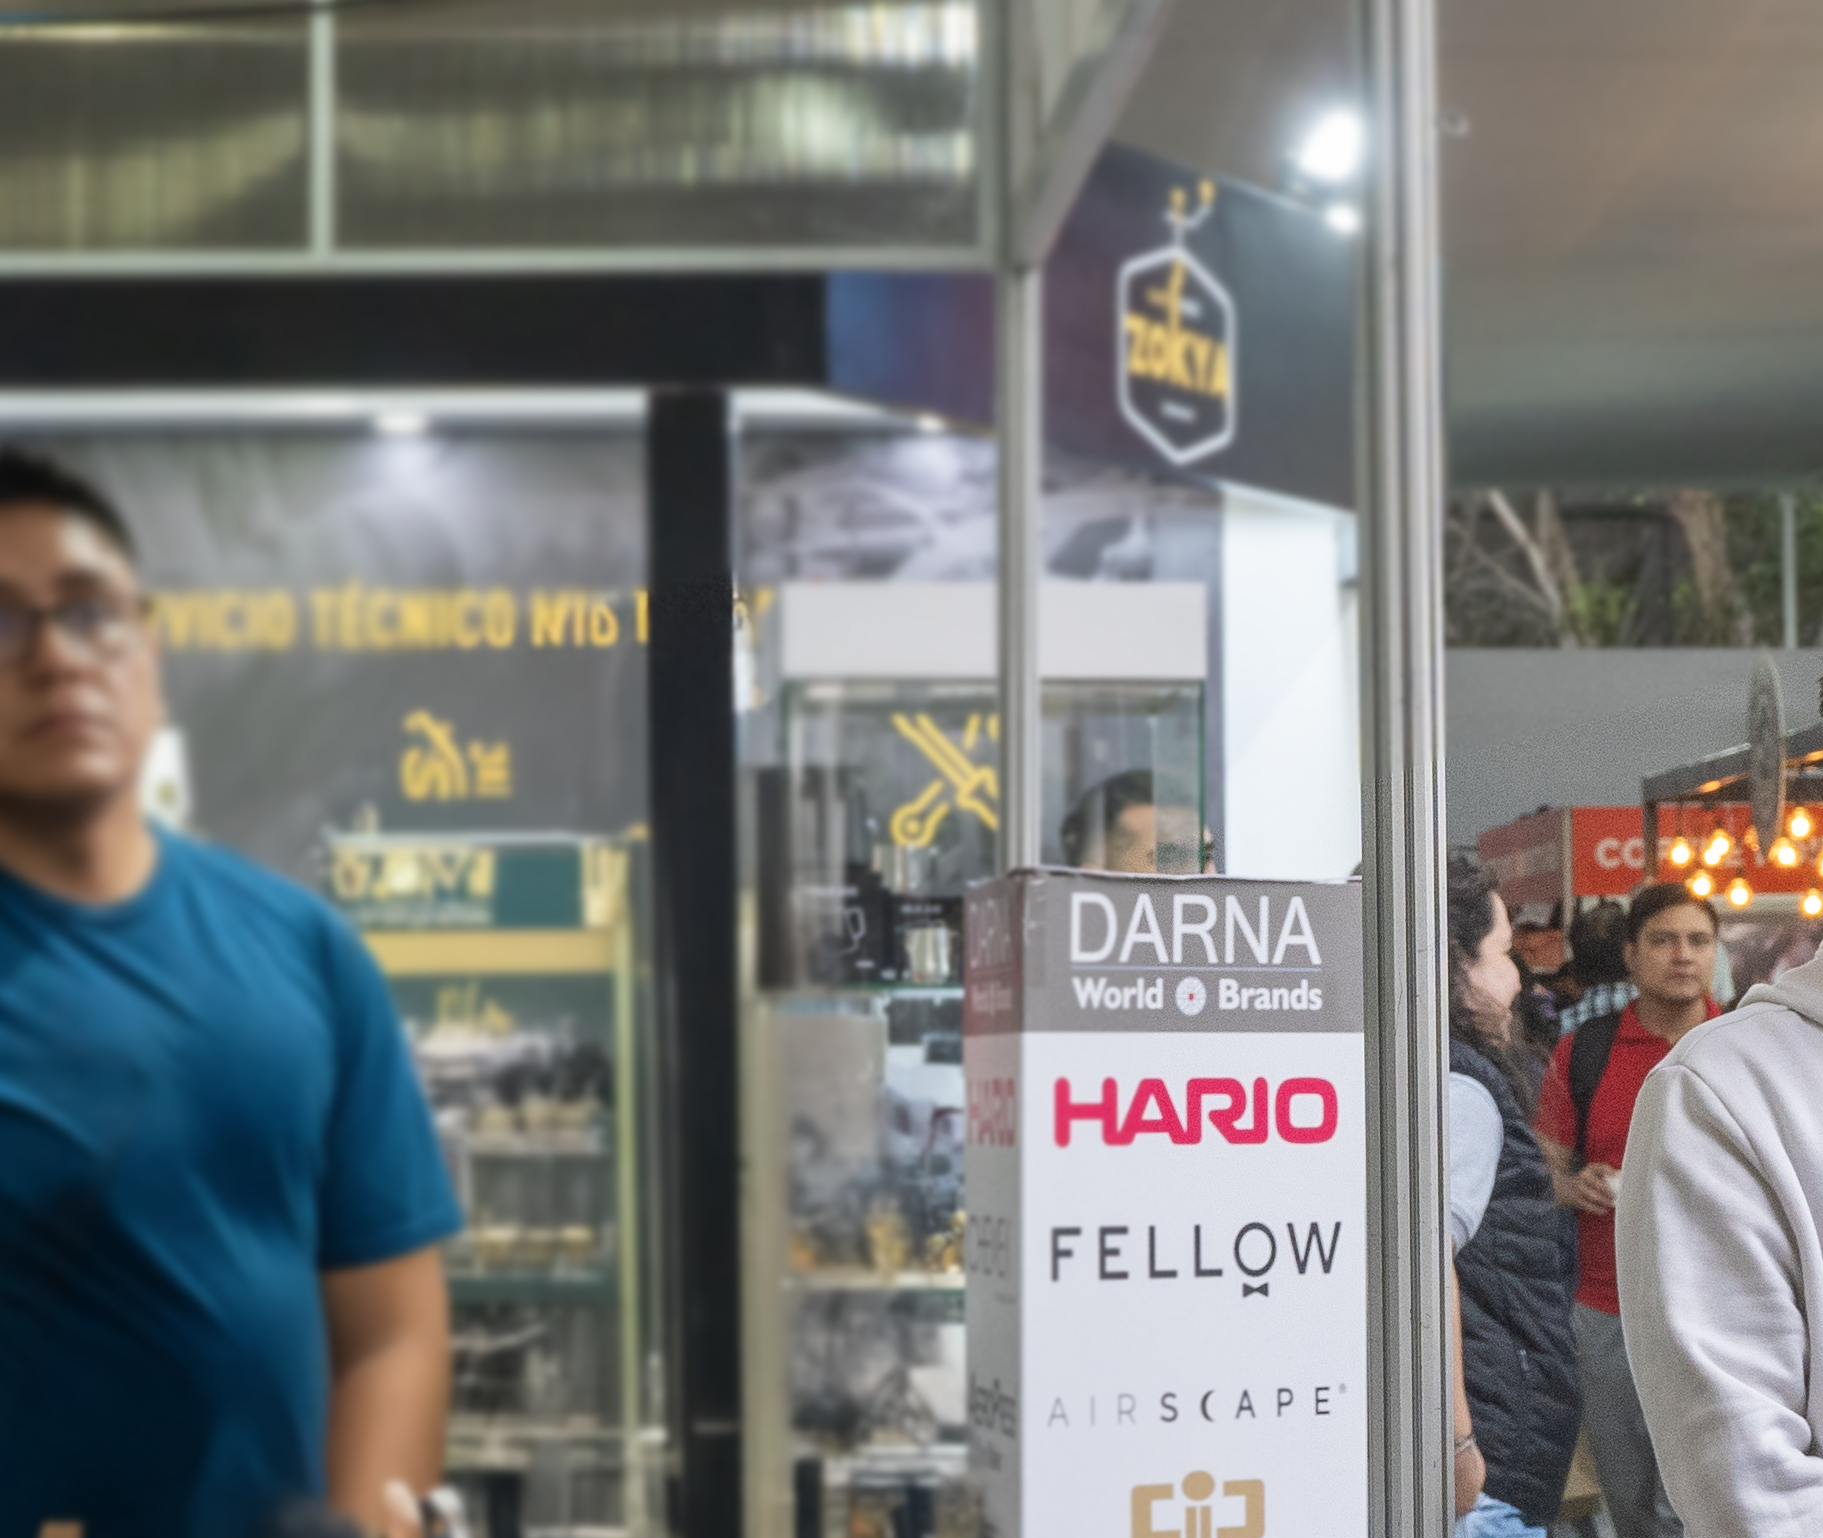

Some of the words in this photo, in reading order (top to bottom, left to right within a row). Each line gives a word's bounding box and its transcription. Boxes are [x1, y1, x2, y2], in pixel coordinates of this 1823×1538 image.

[309, 574, 517, 650] TÉCNICO
[1069, 891, 1322, 966] DARNA
[1072, 977, 1164, 1011] World
[1218, 978, 1323, 1011] Brands
[1054, 1076, 1339, 1148] HARIO
[1050, 1221, 1342, 1284] FELLOW
